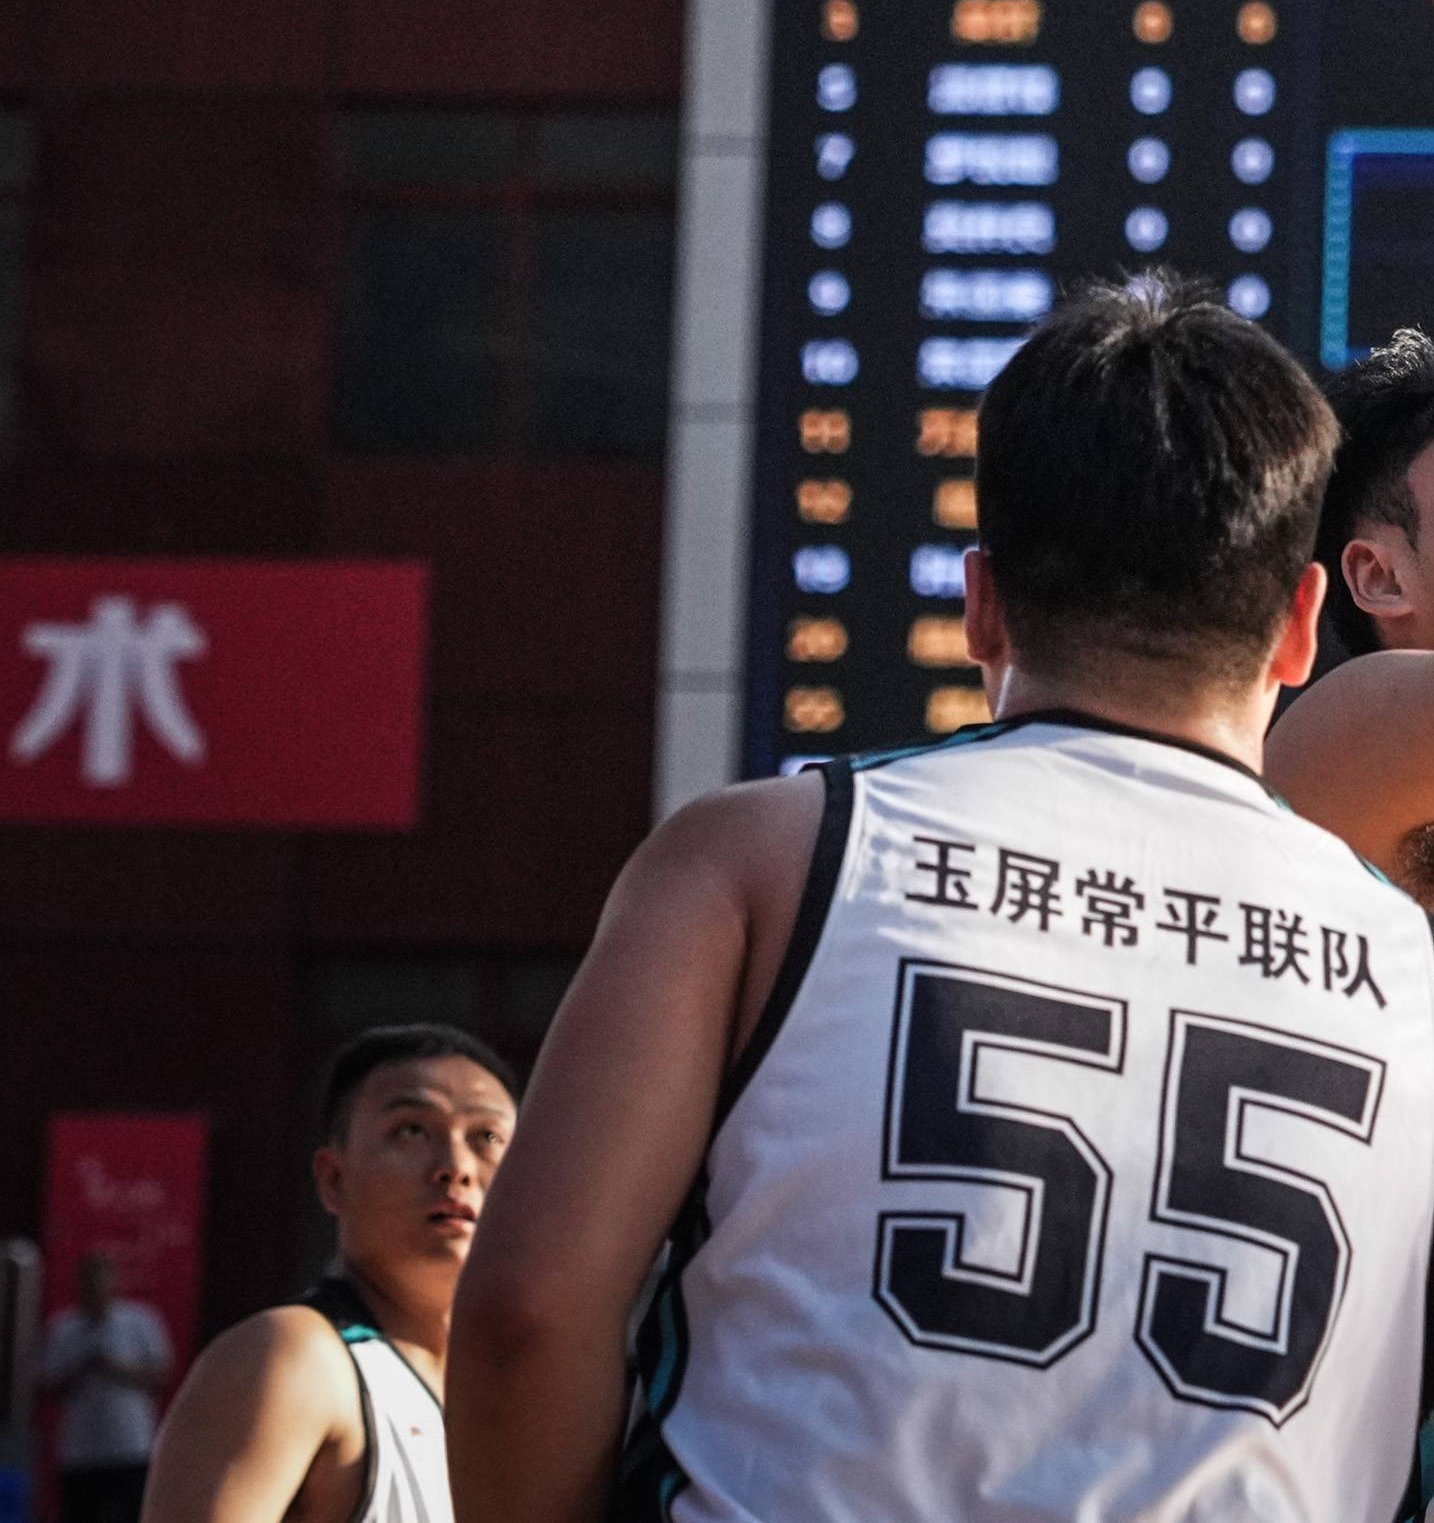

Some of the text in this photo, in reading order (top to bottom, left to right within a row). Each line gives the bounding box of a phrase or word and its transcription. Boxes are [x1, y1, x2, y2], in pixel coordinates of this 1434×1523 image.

[904, 834, 1389, 1010] 玉屏常平联队
[873, 956, 1388, 1429] 55
